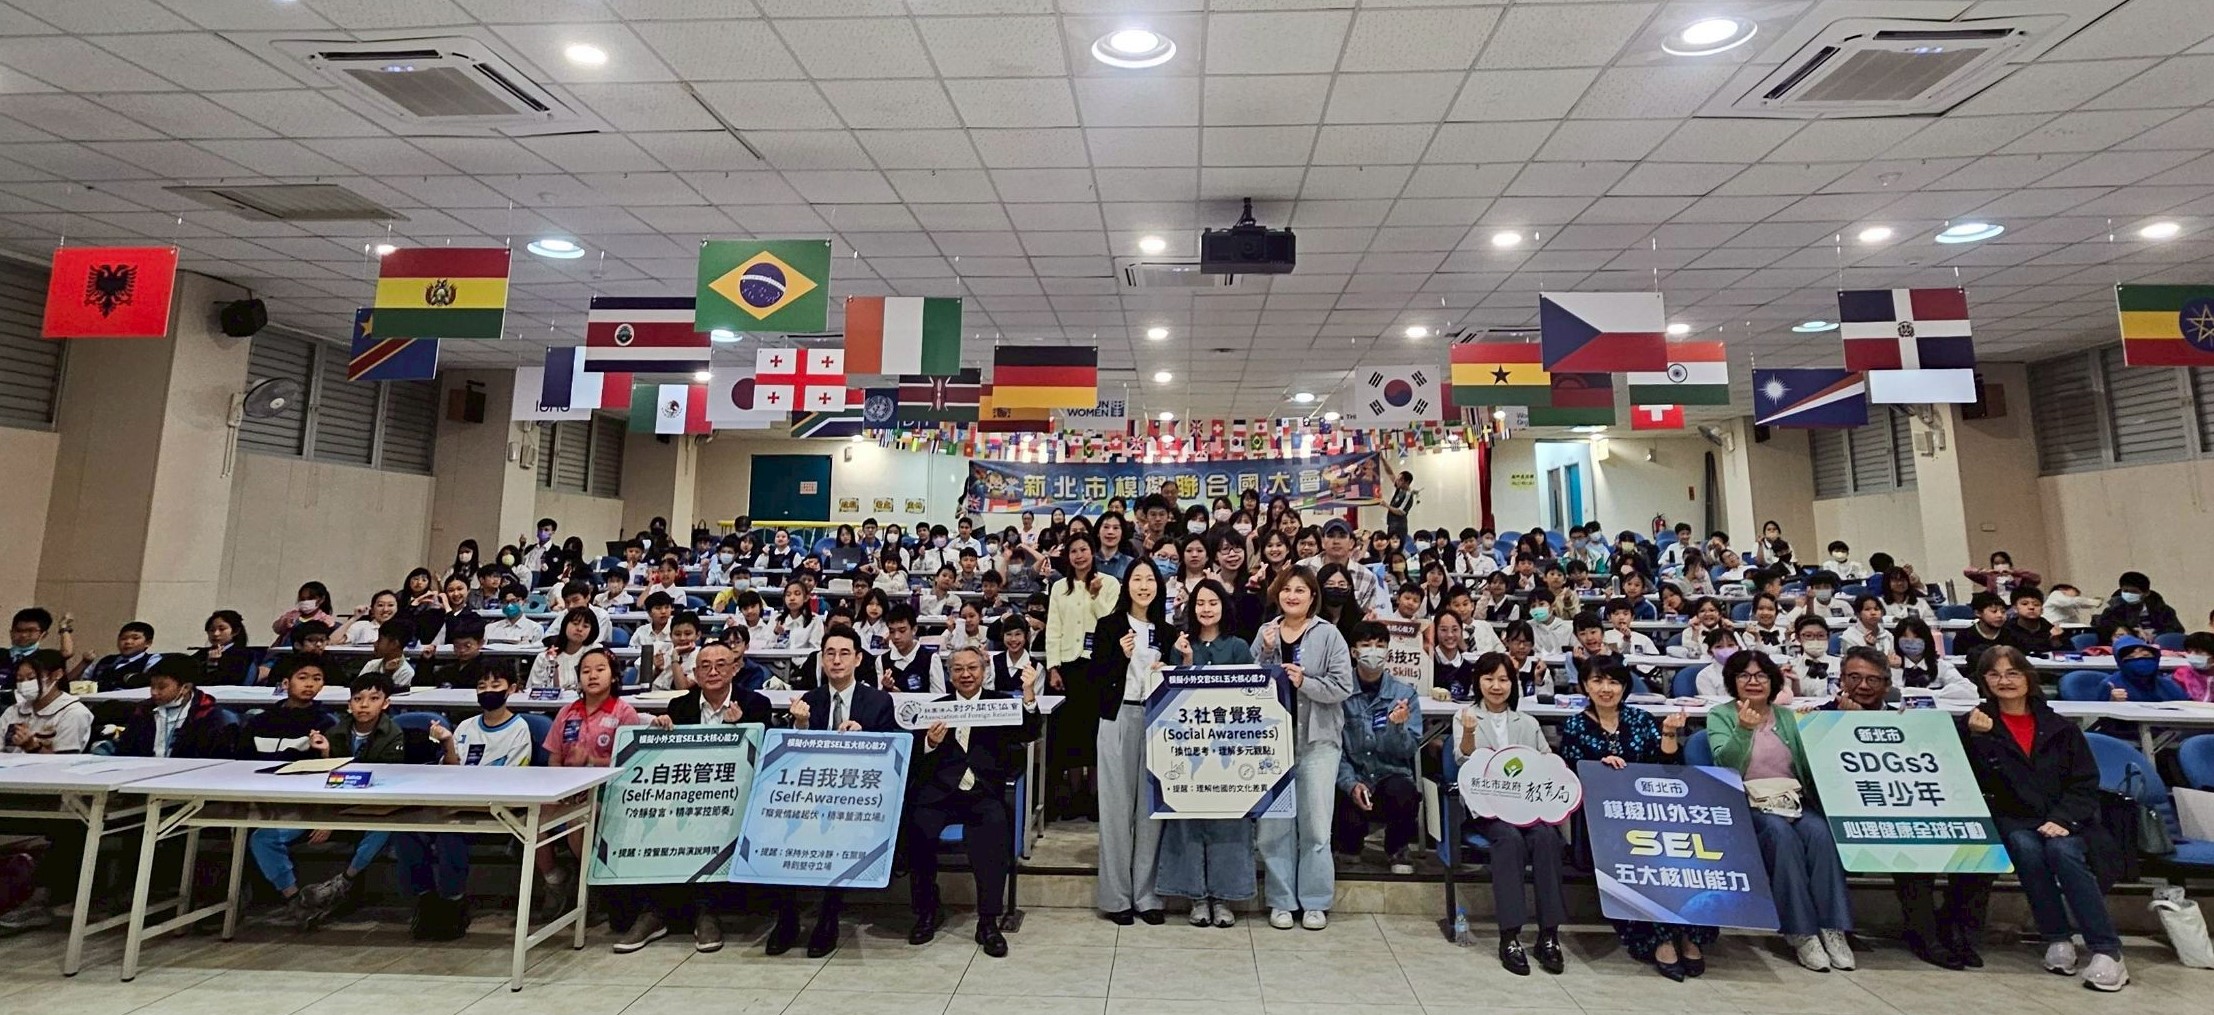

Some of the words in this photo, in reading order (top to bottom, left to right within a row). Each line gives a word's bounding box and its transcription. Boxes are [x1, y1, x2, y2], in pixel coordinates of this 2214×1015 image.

[1067, 408, 1109, 417] WOMEN
[1393, 666, 1422, 680] Skills)
[1178, 706, 1262, 725] 3.社會覺察
[1163, 727, 1205, 742] (Social
[1208, 726, 1279, 741] Awareness)
[1858, 728, 1900, 742] 新北市
[1840, 751, 1939, 773] SDGs3
[632, 762, 736, 785] 2.自我管理
[777, 767, 883, 789] 1.自我覺察
[621, 786, 739, 804] (Self-Management)
[1641, 780, 1683, 794] 新北市
[1855, 780, 1945, 807] 青少年
[769, 789, 883, 807] (Self-Awareness)
[1602, 799, 1733, 826] 模擬小外交官
[1843, 821, 1987, 839] 心理健康全球行動
[1626, 830, 1724, 861] SEL
[1614, 863, 1751, 892] 五大核心能力
